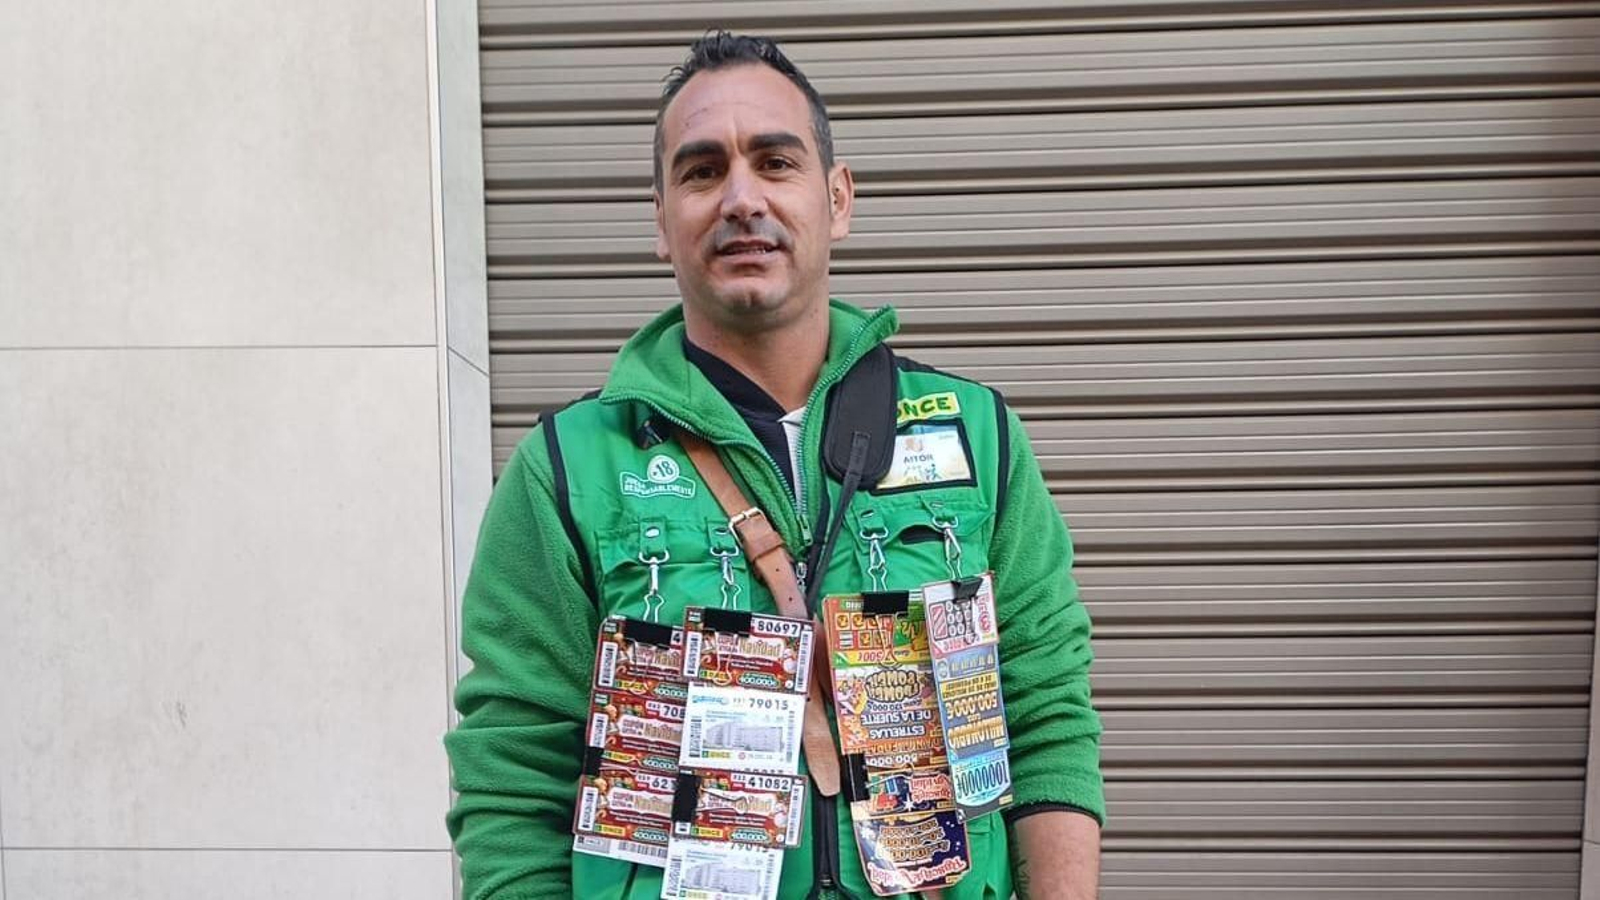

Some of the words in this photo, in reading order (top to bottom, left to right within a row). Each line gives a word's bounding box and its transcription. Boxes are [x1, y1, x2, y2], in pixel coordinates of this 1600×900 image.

[896, 397, 952, 417] NCE
[904, 454, 934, 464] AITOR
[757, 620, 799, 635] 80697
[748, 697, 789, 711] 79015
[861, 712, 900, 725] SUERTE
[901, 711, 916, 723] LA
[917, 709, 932, 720] DE
[869, 725, 925, 739] ESTRELLAS
[748, 777, 789, 791] 41082
